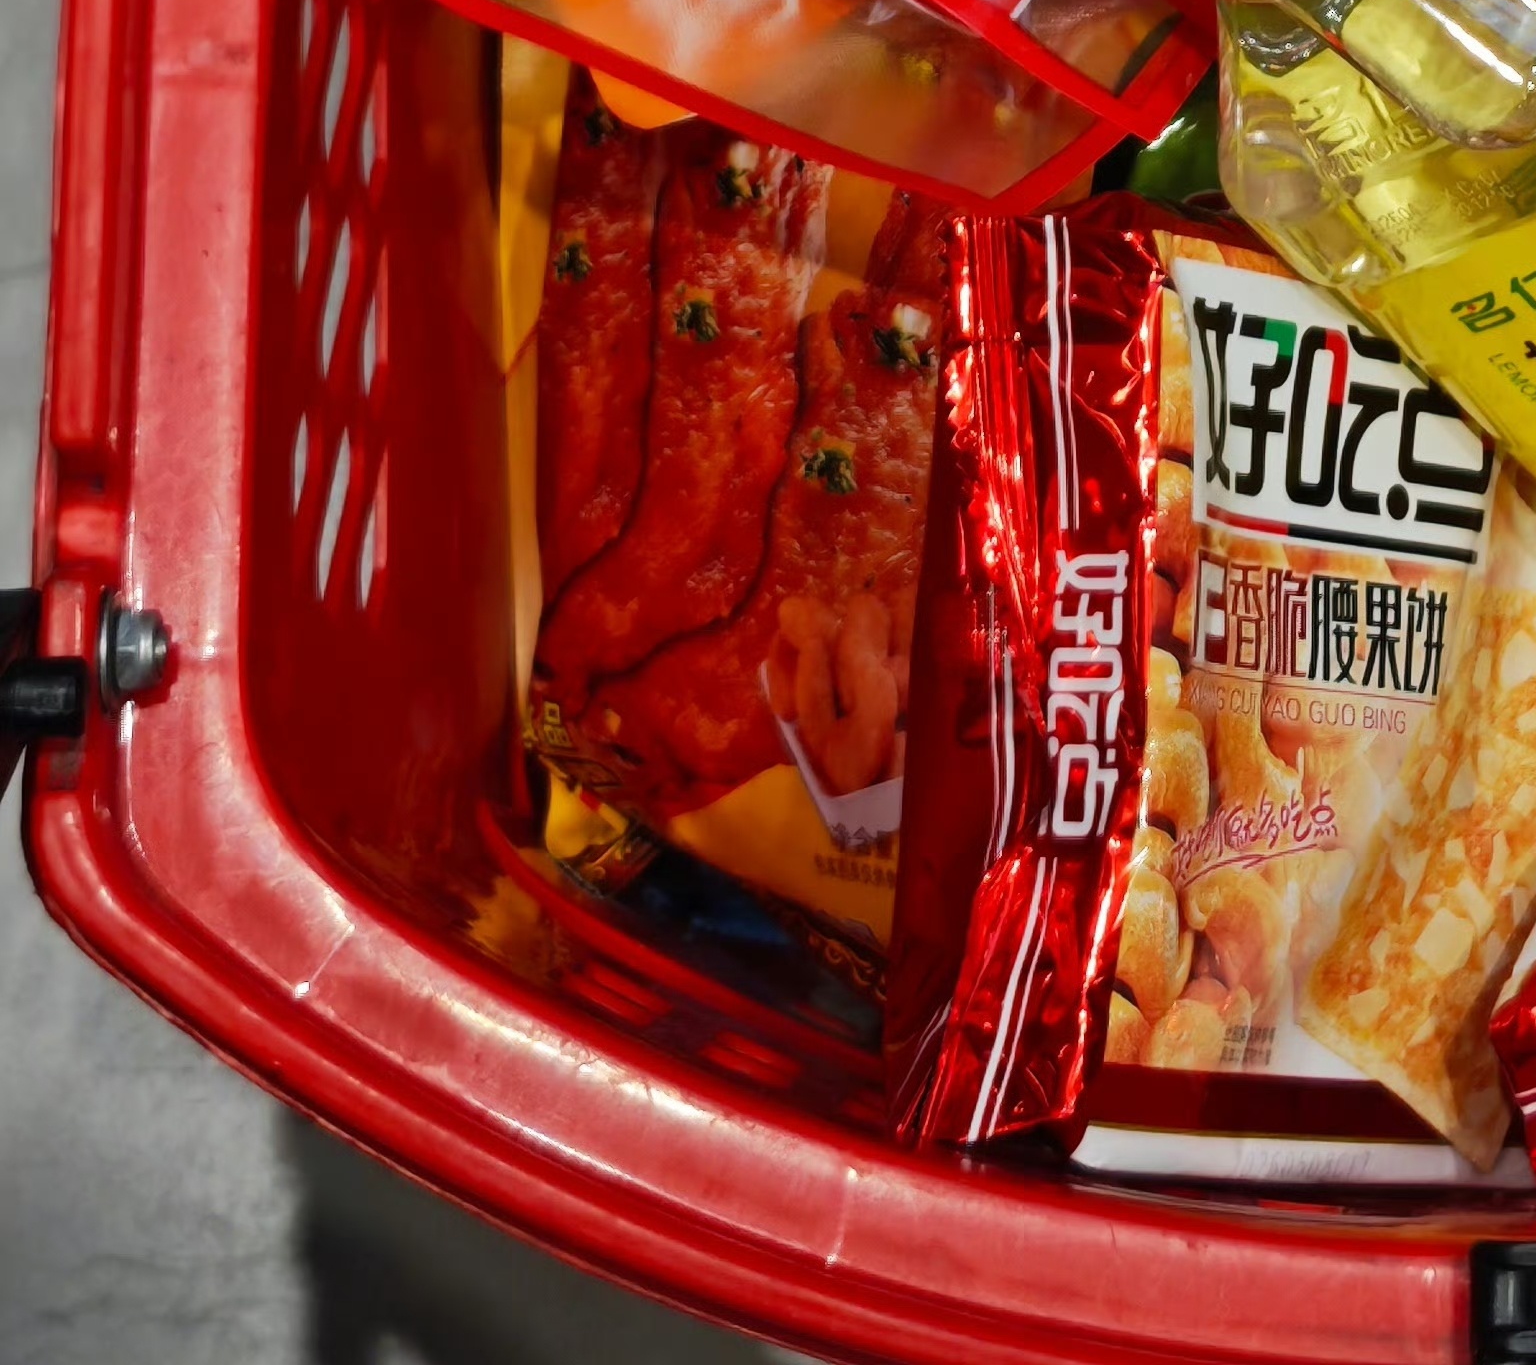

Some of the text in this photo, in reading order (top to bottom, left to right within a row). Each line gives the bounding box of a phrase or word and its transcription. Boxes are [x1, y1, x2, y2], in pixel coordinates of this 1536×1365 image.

[1192, 297, 1494, 534] 好吃点
[1047, 547, 1130, 841] 好吃点
[1229, 563, 1449, 697] 香脆腰果饼
[1260, 691, 1302, 722] YAO
[1308, 699, 1356, 728] GUO
[1361, 705, 1407, 735] BING
